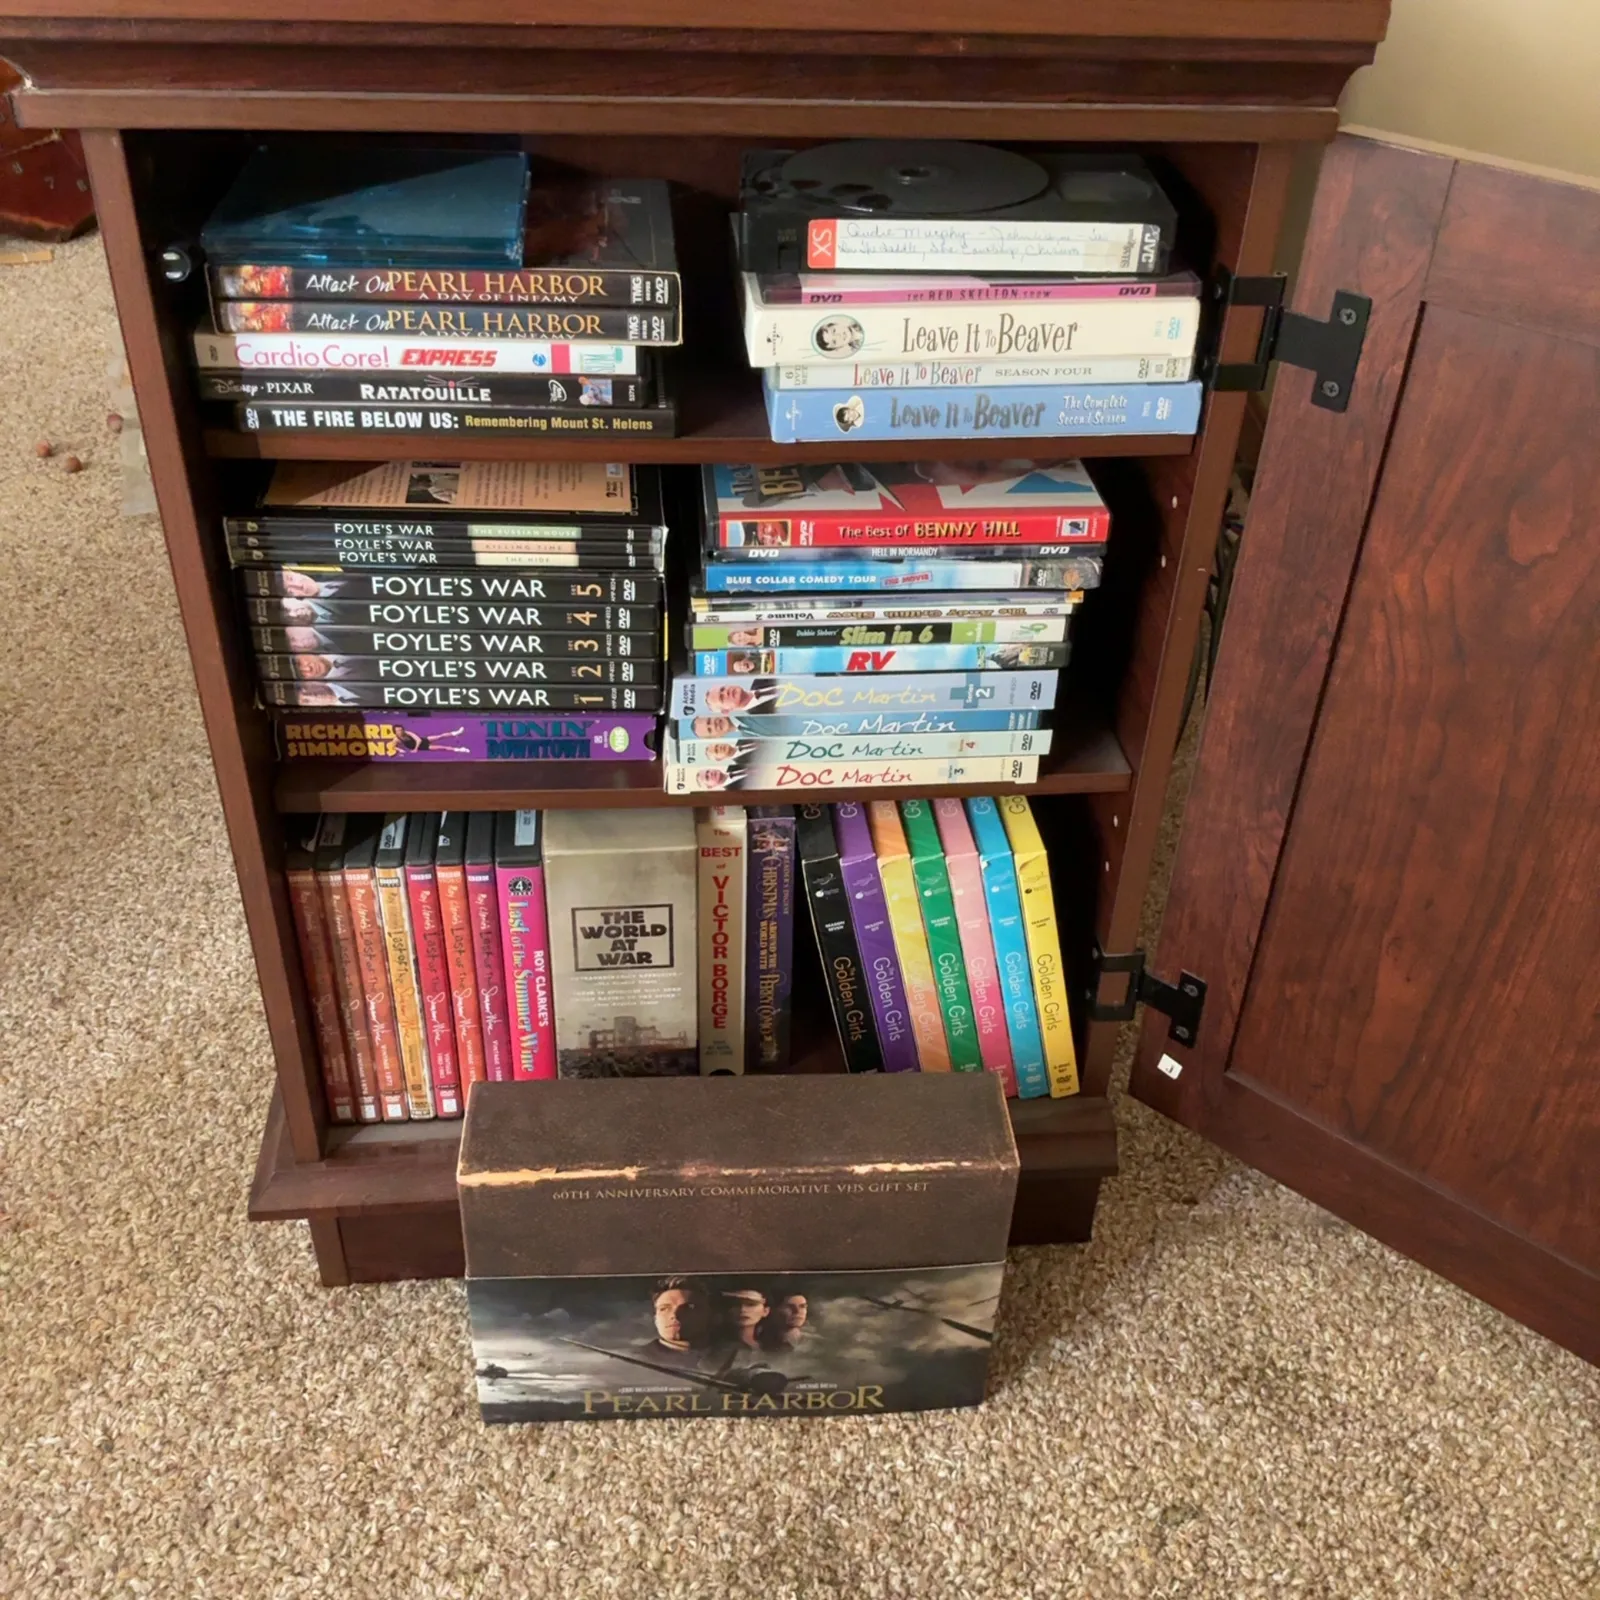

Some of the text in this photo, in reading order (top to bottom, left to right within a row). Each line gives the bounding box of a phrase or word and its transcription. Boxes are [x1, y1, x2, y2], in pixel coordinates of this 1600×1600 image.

[1141, 234, 1157, 263] JVC
[306, 271, 609, 296] Attack On PEARL HARBOR
[630, 275, 643, 304] TMG
[655, 277, 668, 304] DVD
[437, 292, 472, 300] DAY
[479, 293, 503, 301] OF
[510, 293, 578, 302] INFAMY
[810, 287, 1150, 303] DVD RED SKELTON DVD
[306, 310, 605, 334] Attack On PEARL HARBOR
[628, 314, 639, 340] TMG
[902, 318, 959, 354] Leave
[964, 322, 981, 355] It
[997, 313, 1078, 355] Beaver
[235, 341, 498, 368] Cardio Core! EXPRESS
[854, 362, 1092, 386] Leave It To Beaver SEASON FOUR
[266, 382, 314, 395] PIXAR
[890, 393, 1046, 430] Leave It Beaver
[1063, 395, 1081, 410] The
[272, 410, 653, 431] THE FIRE BELOW US: Remembering Mount St. Helens
[334, 523, 434, 536] FOYLE'S WAR
[838, 520, 1021, 538] The Best BENNY HILL
[334, 539, 434, 551] FOYLE'S WAR
[748, 550, 780, 558] DVD
[898, 547, 938, 556] NORMANDY
[1039, 546, 1070, 554] DVD
[339, 551, 438, 564] FOYLE'S WAR
[371, 576, 547, 598] FOYLE'S WAR
[726, 576, 751, 584] BLUE
[756, 576, 795, 584] COLLAR
[800, 576, 844, 584] COMEDY
[577, 584, 602, 598] 5
[369, 605, 542, 626] FOYLE'S WAR
[573, 611, 598, 626] 4
[373, 633, 544, 653] FOYLE'S WAR
[840, 626, 934, 646] Slim in 6
[574, 640, 599, 652] 3
[379, 660, 547, 679] FOYLE'S WAR
[846, 651, 896, 671] RV
[577, 664, 602, 678] 2
[383, 687, 550, 706] FOYLE'S WAR
[580, 696, 604, 704] 1
[853, 684, 936, 704] Martin
[976, 687, 990, 698] 2
[285, 724, 397, 740] RICHARD
[858, 712, 956, 733] Martin
[288, 741, 397, 757] SIMMONS
[853, 741, 923, 756] Martin
[966, 741, 976, 749] 4
[842, 769, 912, 784] Martin
[713, 829, 730, 837] The
[701, 847, 742, 857] BEST
[515, 880, 523, 891] 4
[600, 910, 645, 925] THE
[712, 876, 729, 959] VICTOR
[580, 924, 667, 939] WORLD
[611, 939, 638, 952] AT
[596, 952, 653, 966] WAR
[508, 901, 538, 1072] Last of the Summer Wine
[534, 950, 549, 1027] ROY CLARKE'S
[711, 963, 729, 1029] BORGE
[938, 952, 968, 1037] Golden Girls
[971, 956, 999, 1034] Golden Girls
[1005, 951, 1030, 1030] Golden Girls
[1037, 953, 1062, 1031] Golden Girls
[834, 956, 867, 1041] Golden Girls
[873, 956, 896, 1008] Golden
[885, 1010, 905, 1041] Girls
[553, 1182, 931, 1200] 60TH ANNIVERSARY COMMEMORATIVE VHS GIFT SET
[582, 1384, 884, 1414] PEARL HARBOR
